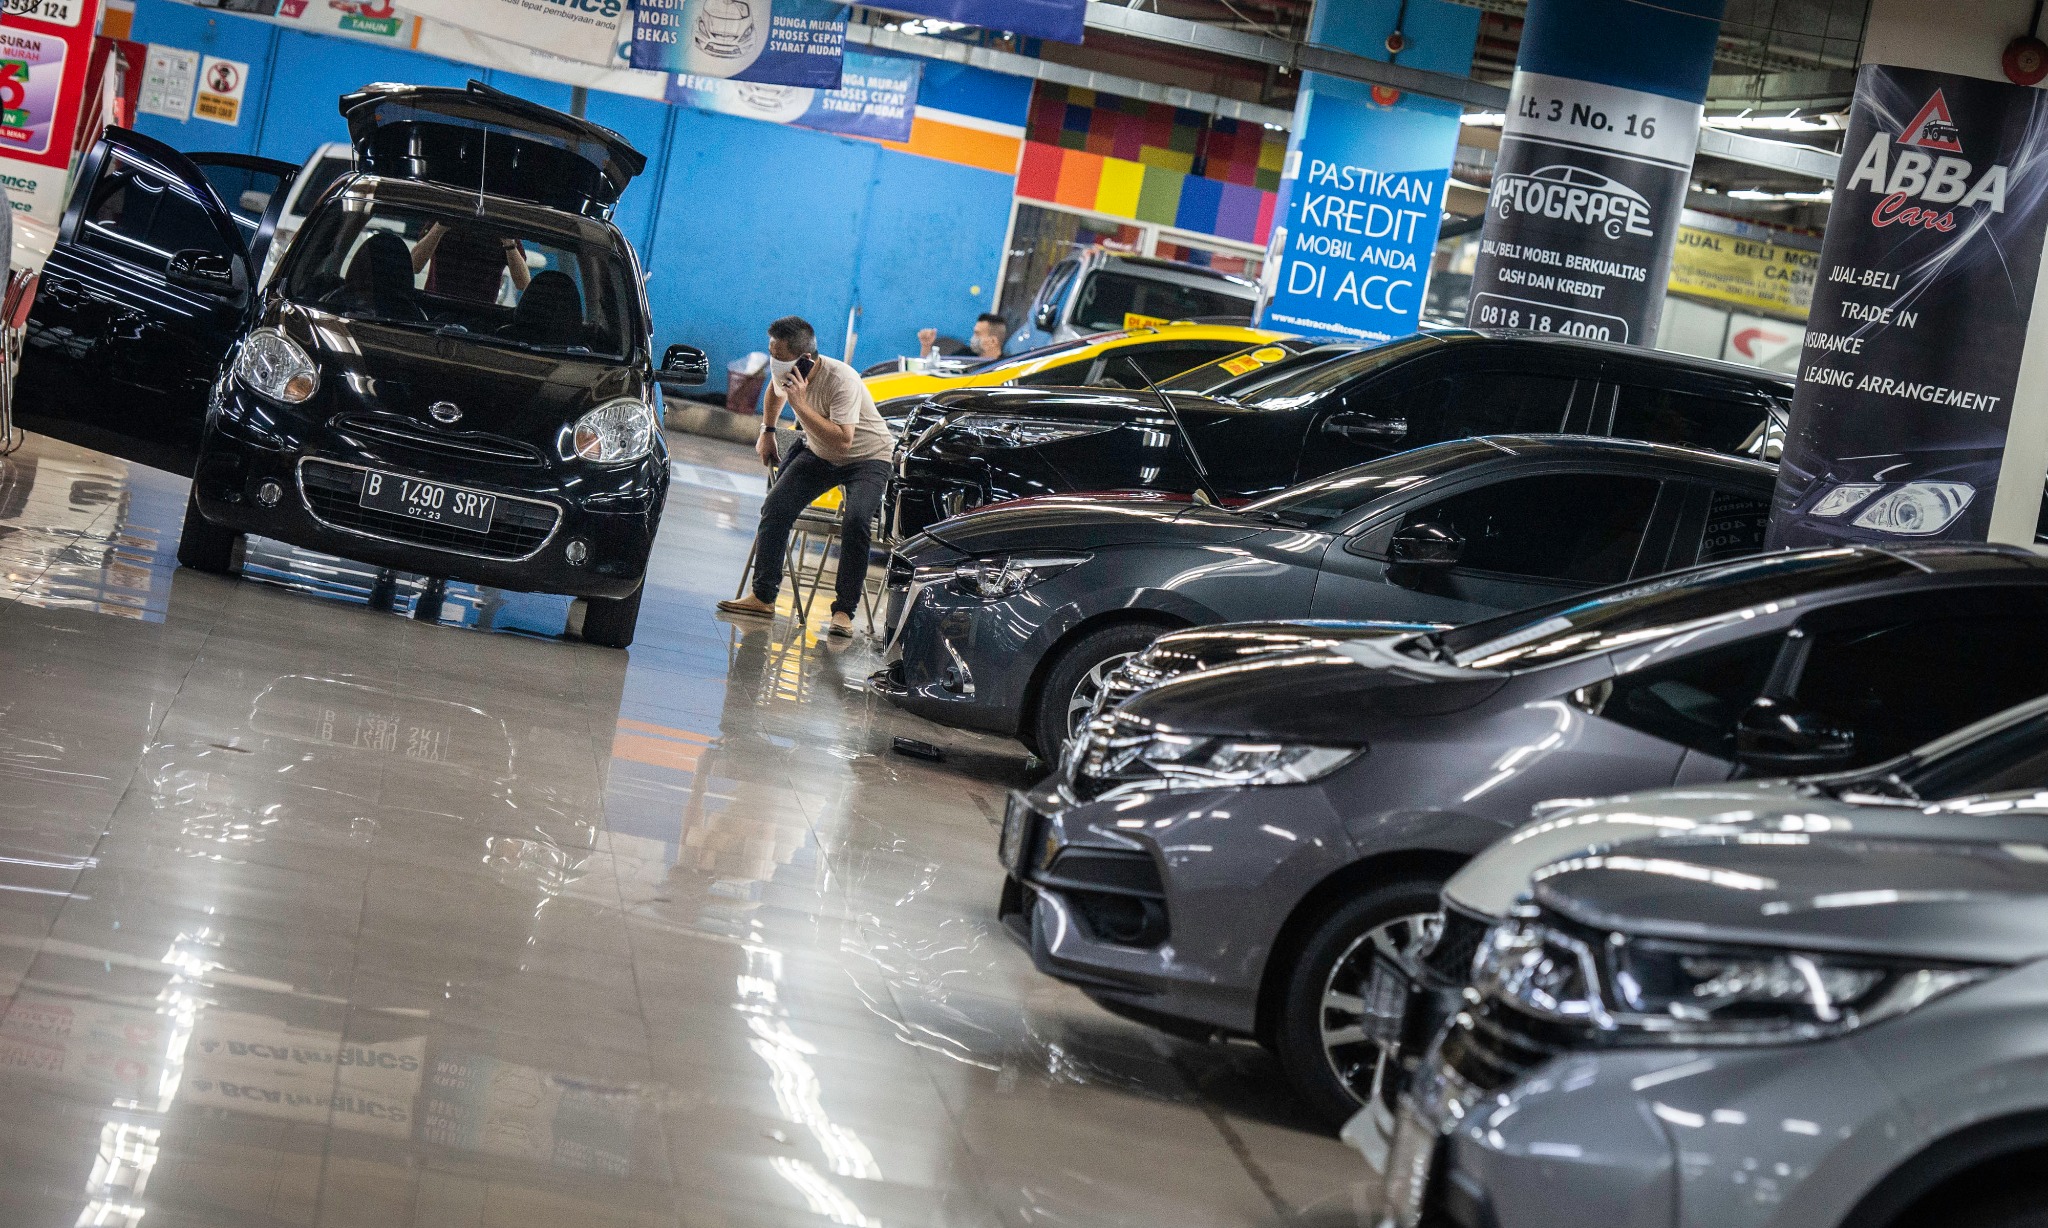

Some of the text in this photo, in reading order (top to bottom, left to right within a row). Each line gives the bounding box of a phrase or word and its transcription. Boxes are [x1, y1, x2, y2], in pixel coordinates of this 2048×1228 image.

[43, 2, 68, 20] 124
[521, 1, 543, 11] tepat
[542, 6, 594, 25] pembiayaan
[595, 18, 616, 31] anda
[638, 10, 680, 28] MOBIL
[773, 16, 844, 32] BUNGA MURAH
[636, 27, 678, 44] BEKAS
[770, 41, 842, 57] SYARAT MUDAH
[771, 29, 842, 45] PROSES CEPAT
[2, 47, 40, 61] MURAH
[866, 76, 909, 93] MURAH
[1518, 95, 1657, 140] Lt. 3 No. 16
[1308, 158, 1434, 207] PASTIKAN
[1845, 130, 2009, 214] ABBA
[1300, 190, 1428, 245] KREDIT
[1871, 191, 1957, 233] Cars
[1295, 232, 1417, 273] MOBIL ANDA
[1678, 232, 1723, 252] JUAL
[1733, 242, 1775, 262] BELI
[1522, 246, 1563, 267] MOBIL
[1565, 254, 1648, 283] BERKUALITAS
[1763, 265, 1814, 286] CASH
[1828, 265, 1900, 291] JUAL-BELI
[1287, 259, 1414, 315] DI ACC
[1499, 267, 1606, 300] CASH DAN KREDIT
[1480, 304, 1611, 343] 0818 18 4000
[1840, 300, 1919, 329] TRADE IN
[1803, 365, 2001, 413] LEASING ARRANGEMENT
[368, 473, 490, 519] B 1490 SRY
